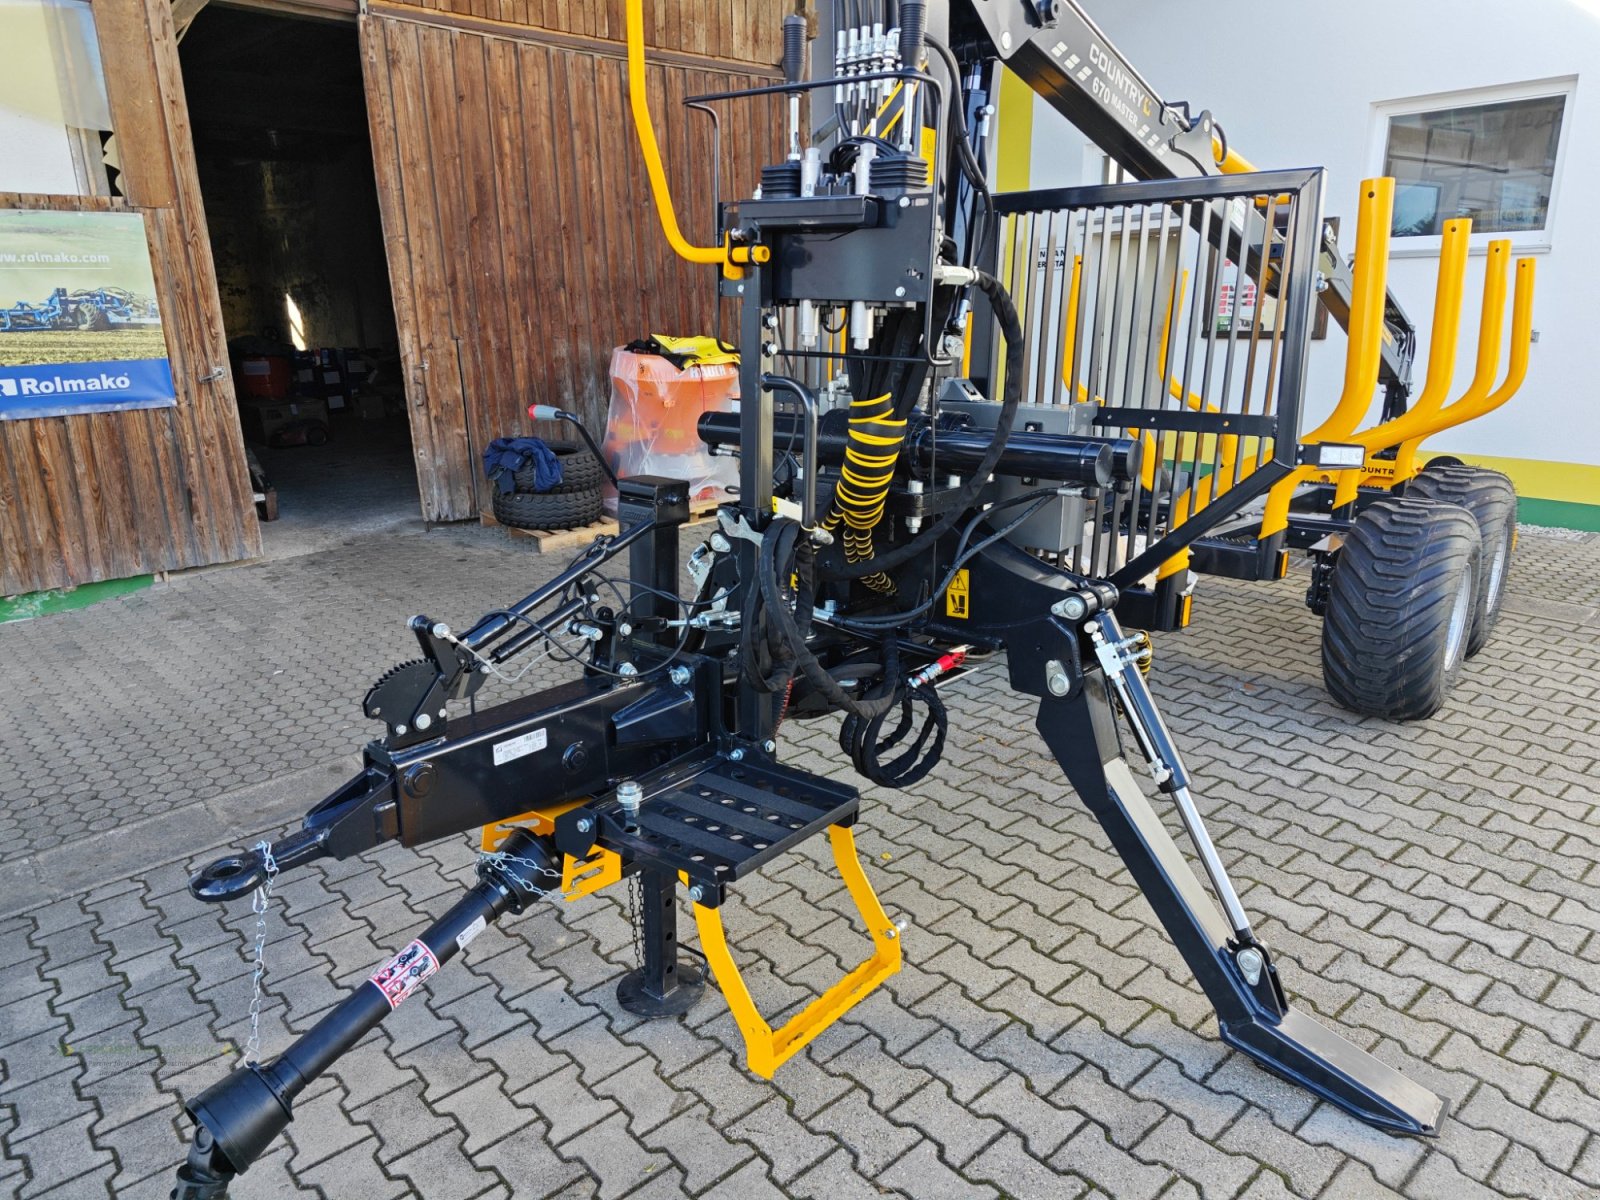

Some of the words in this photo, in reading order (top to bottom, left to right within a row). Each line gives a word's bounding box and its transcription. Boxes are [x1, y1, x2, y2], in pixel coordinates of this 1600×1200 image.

[1089, 43, 1145, 107] COUNTRY
[1092, 76, 1111, 105] 670
[1110, 93, 1138, 127] MASTER
[20, 374, 131, 395] Rolmako
[1361, 466, 1395, 475] OUNTR
